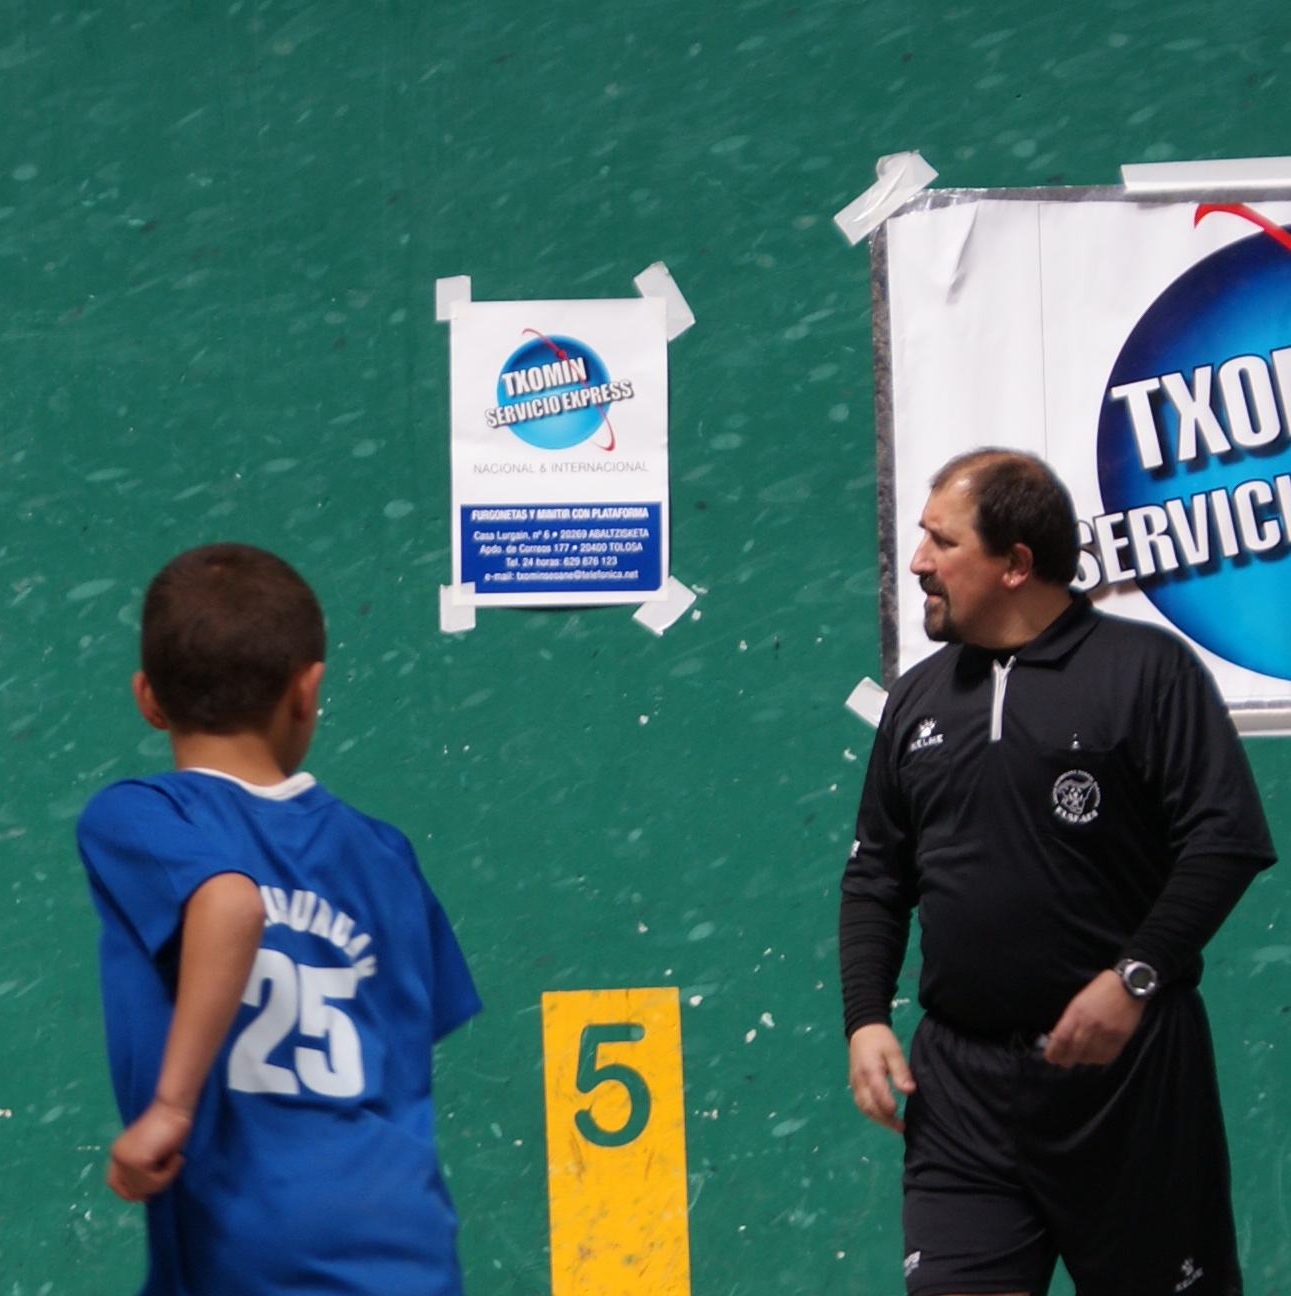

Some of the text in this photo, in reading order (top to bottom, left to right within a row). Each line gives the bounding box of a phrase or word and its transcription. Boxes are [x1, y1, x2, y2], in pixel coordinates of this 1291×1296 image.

[502, 357, 588, 397] TXOMIN
[485, 380, 634, 428] SERVICIO EXPRESS
[473, 461, 649, 474] NACIONAL & INTERNACIONAL
[530, 509, 535, 519] Y
[572, 508, 590, 519] CON
[592, 507, 649, 520] PLATAFORMA
[473, 531, 494, 540] Casa
[543, 530, 550, 539] 6
[506, 545, 517, 554] de
[554, 543, 570, 553] 177
[609, 542, 643, 552] TOLOSA
[506, 557, 520, 567] Tel.
[522, 557, 533, 567] 24
[601, 556, 618, 566] 123
[910, 733, 945, 751] KELME
[227, 949, 366, 1099] 25
[574, 1023, 652, 1148] 5
